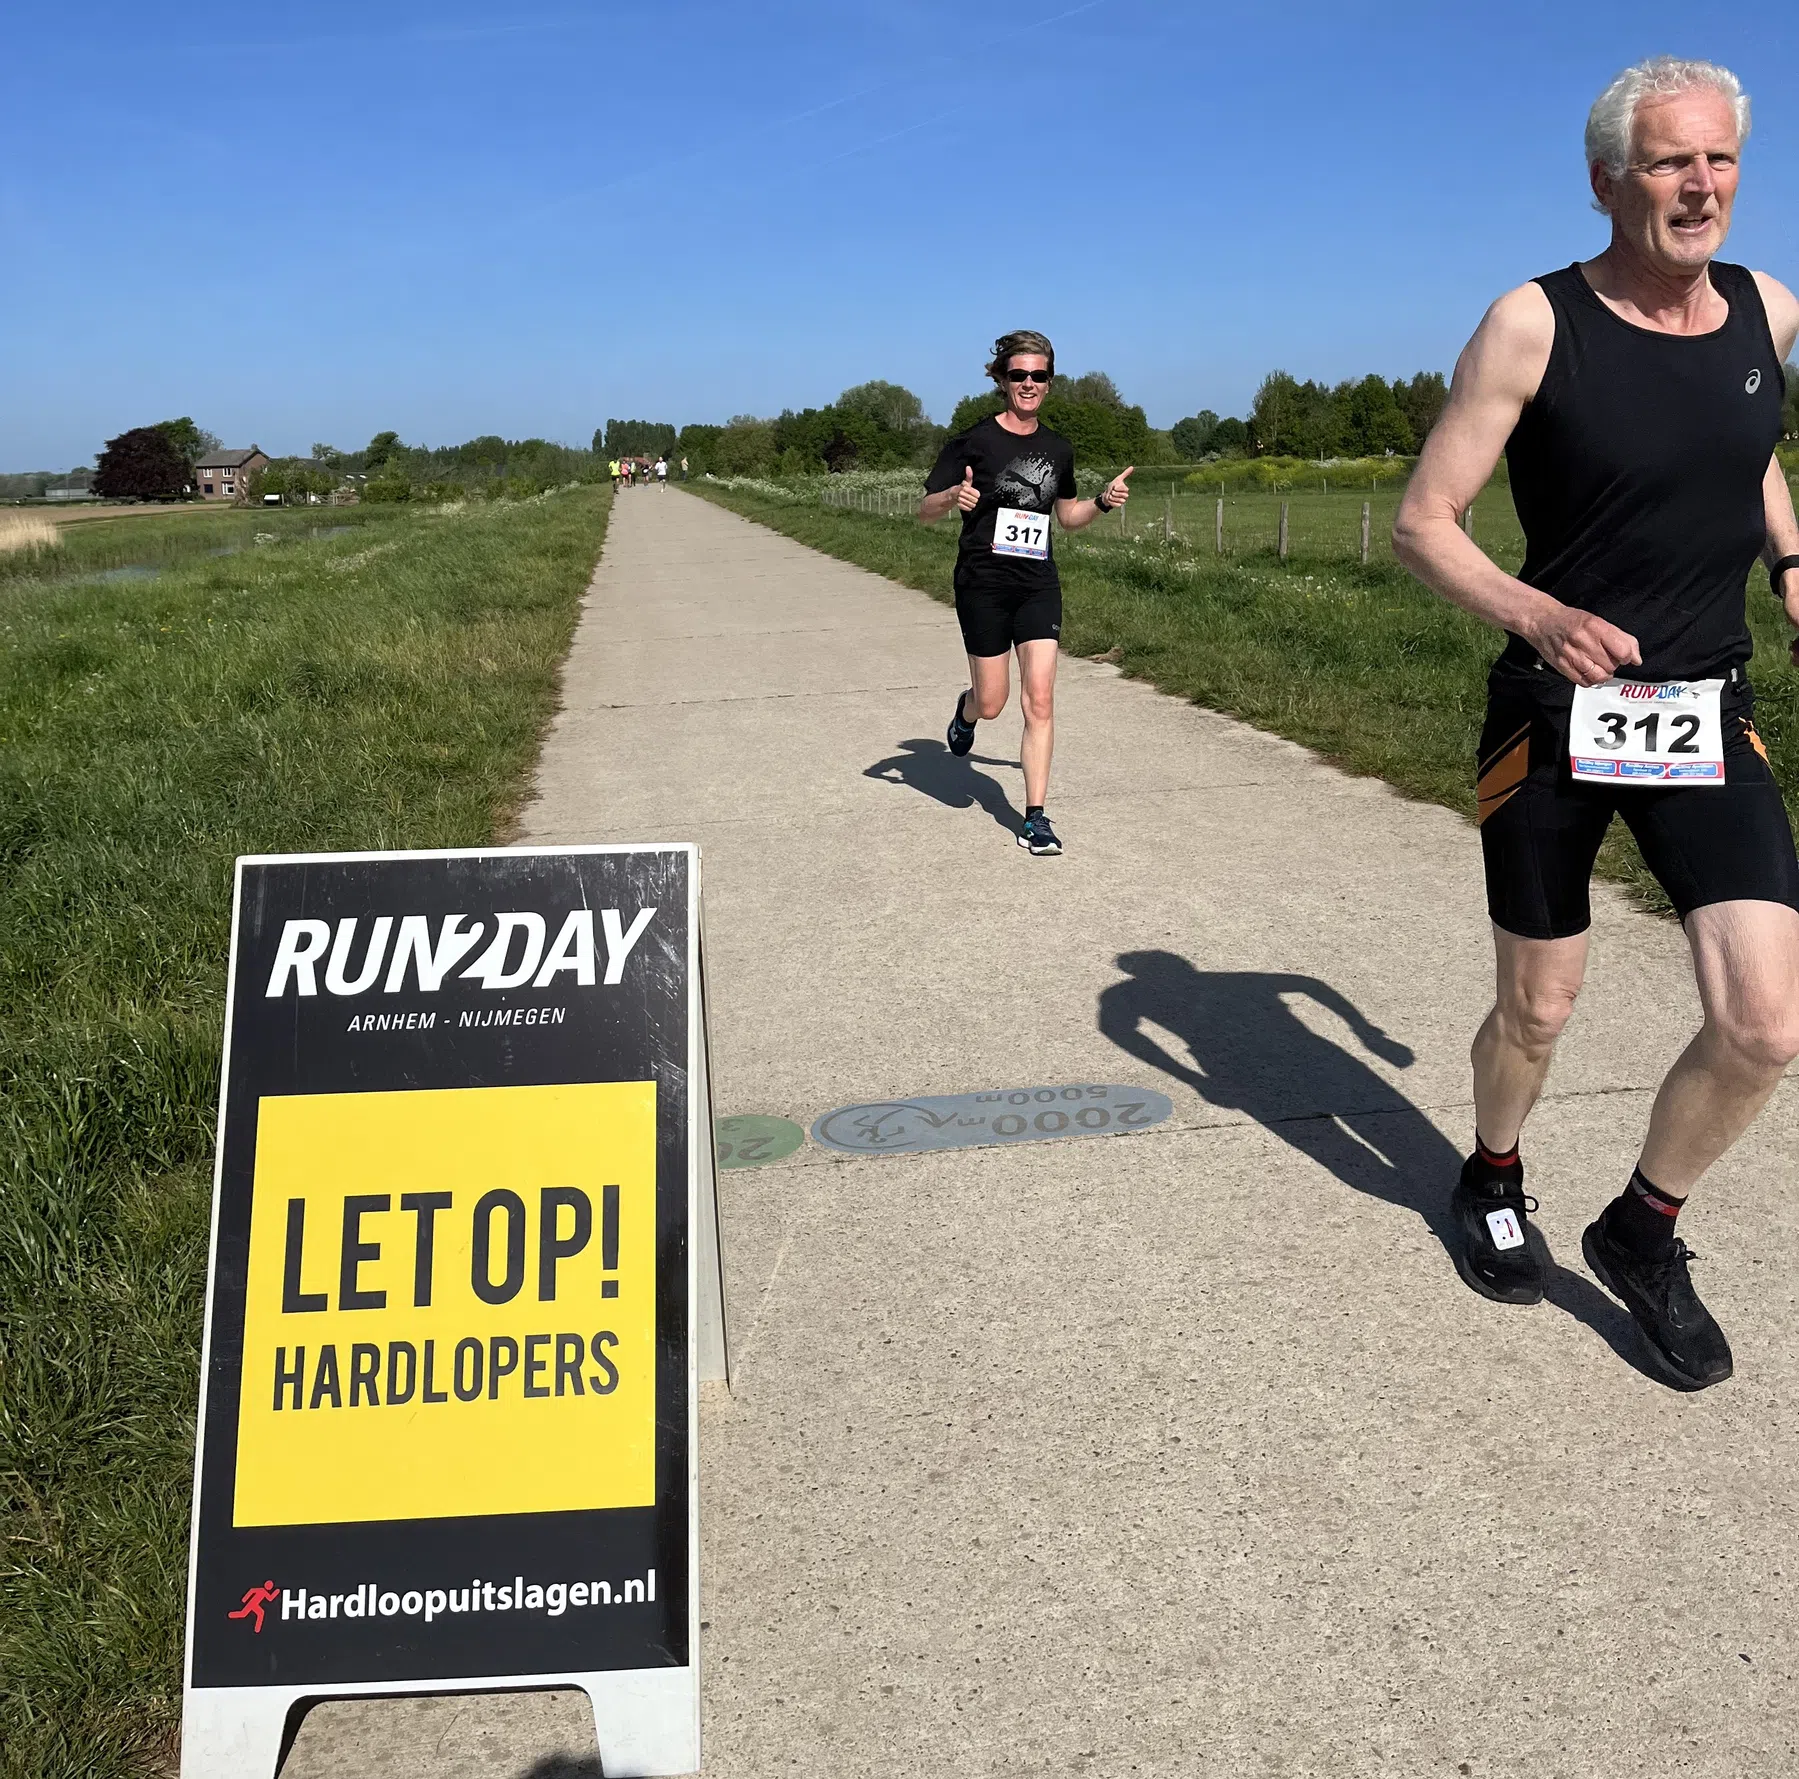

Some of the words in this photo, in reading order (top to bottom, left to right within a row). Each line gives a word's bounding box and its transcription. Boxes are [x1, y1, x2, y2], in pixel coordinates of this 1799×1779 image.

[1005, 525, 1042, 545] 317
[1594, 712, 1701, 754] 312
[265, 907, 658, 998] RUN2DAY
[347, 1012, 437, 1032] ARNHEM
[458, 1007, 566, 1028] NIJMEGEN
[976, 1085, 1109, 1105] 5000m
[282, 1192, 453, 1314] LET
[472, 1184, 620, 1305] OP!
[273, 1331, 620, 1411] HARDLOPERS
[281, 1568, 656, 1623] Hardloopuitslagen.nl
